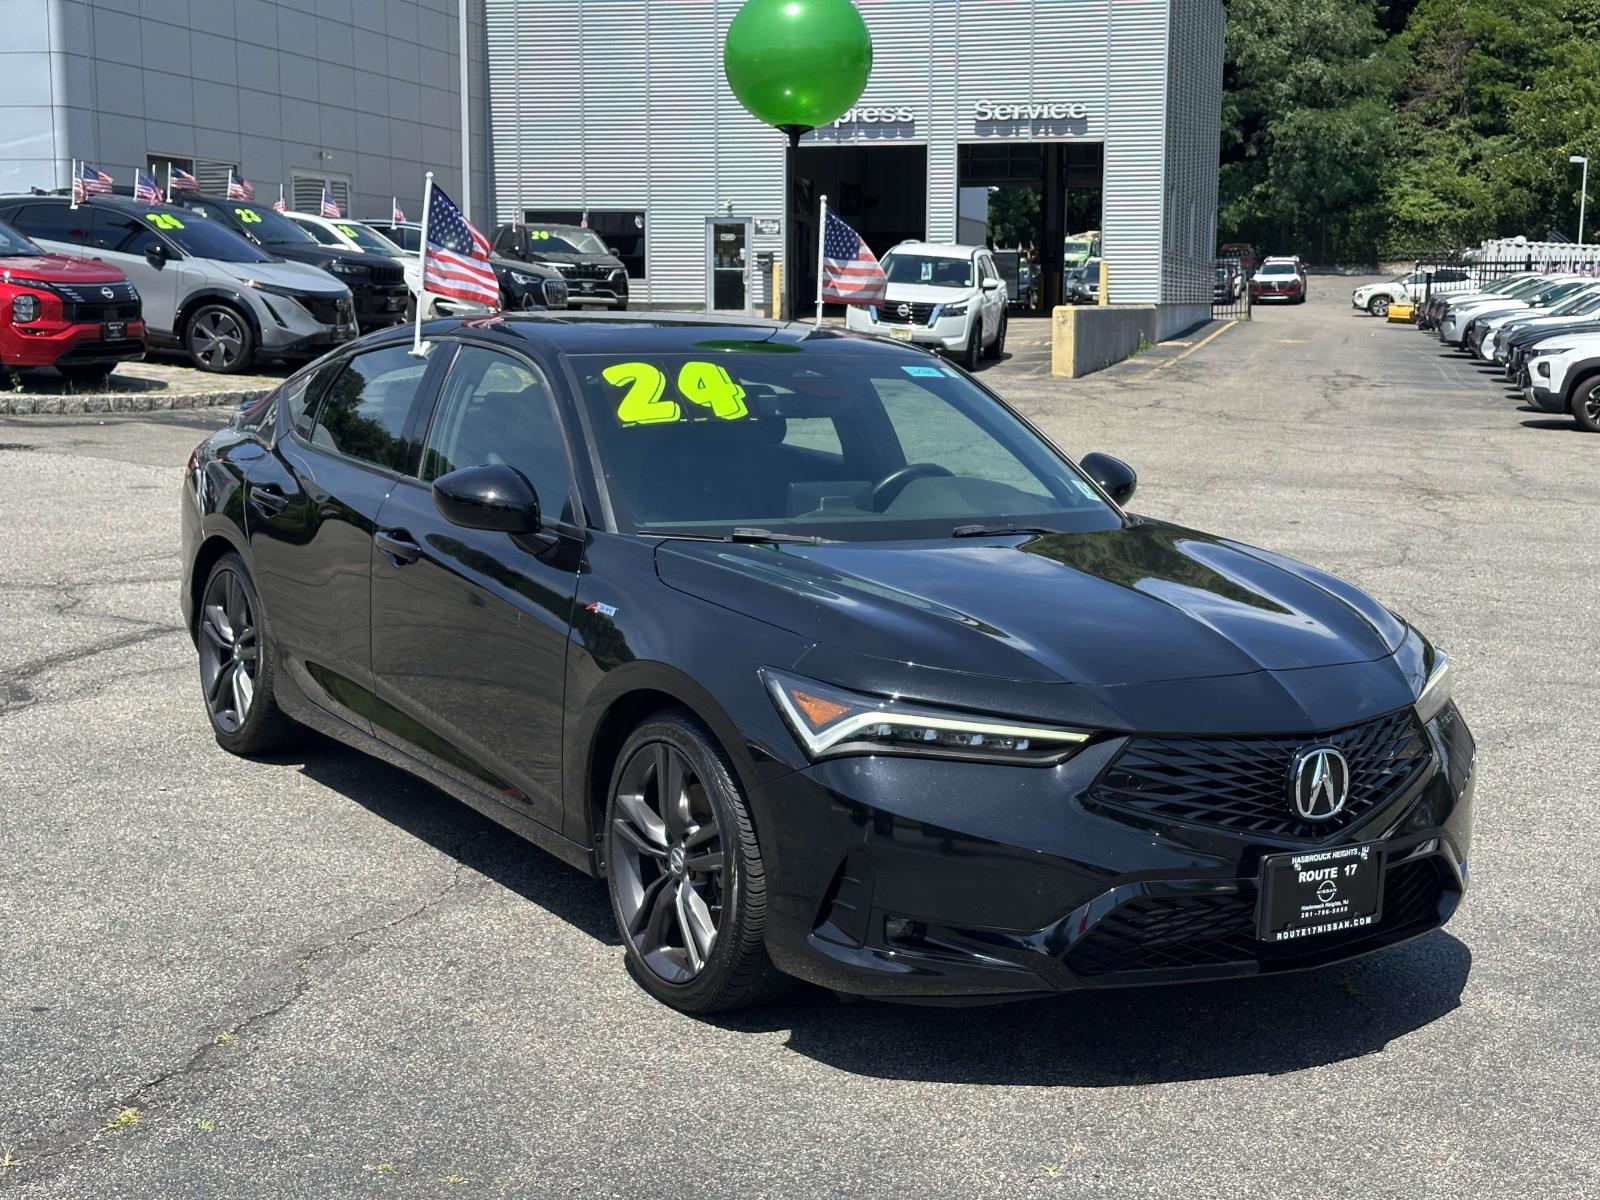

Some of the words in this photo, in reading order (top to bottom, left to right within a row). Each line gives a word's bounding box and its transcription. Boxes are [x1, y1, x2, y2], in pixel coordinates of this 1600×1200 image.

[975, 99, 1087, 120] Service
[602, 361, 749, 425] 24
[1292, 852, 1331, 864] HASBROUCK
[1298, 867, 1338, 882] ROUTE
[1344, 864, 1358, 876] 17
[1277, 917, 1372, 940] ROUTE17NISSAN.COM
